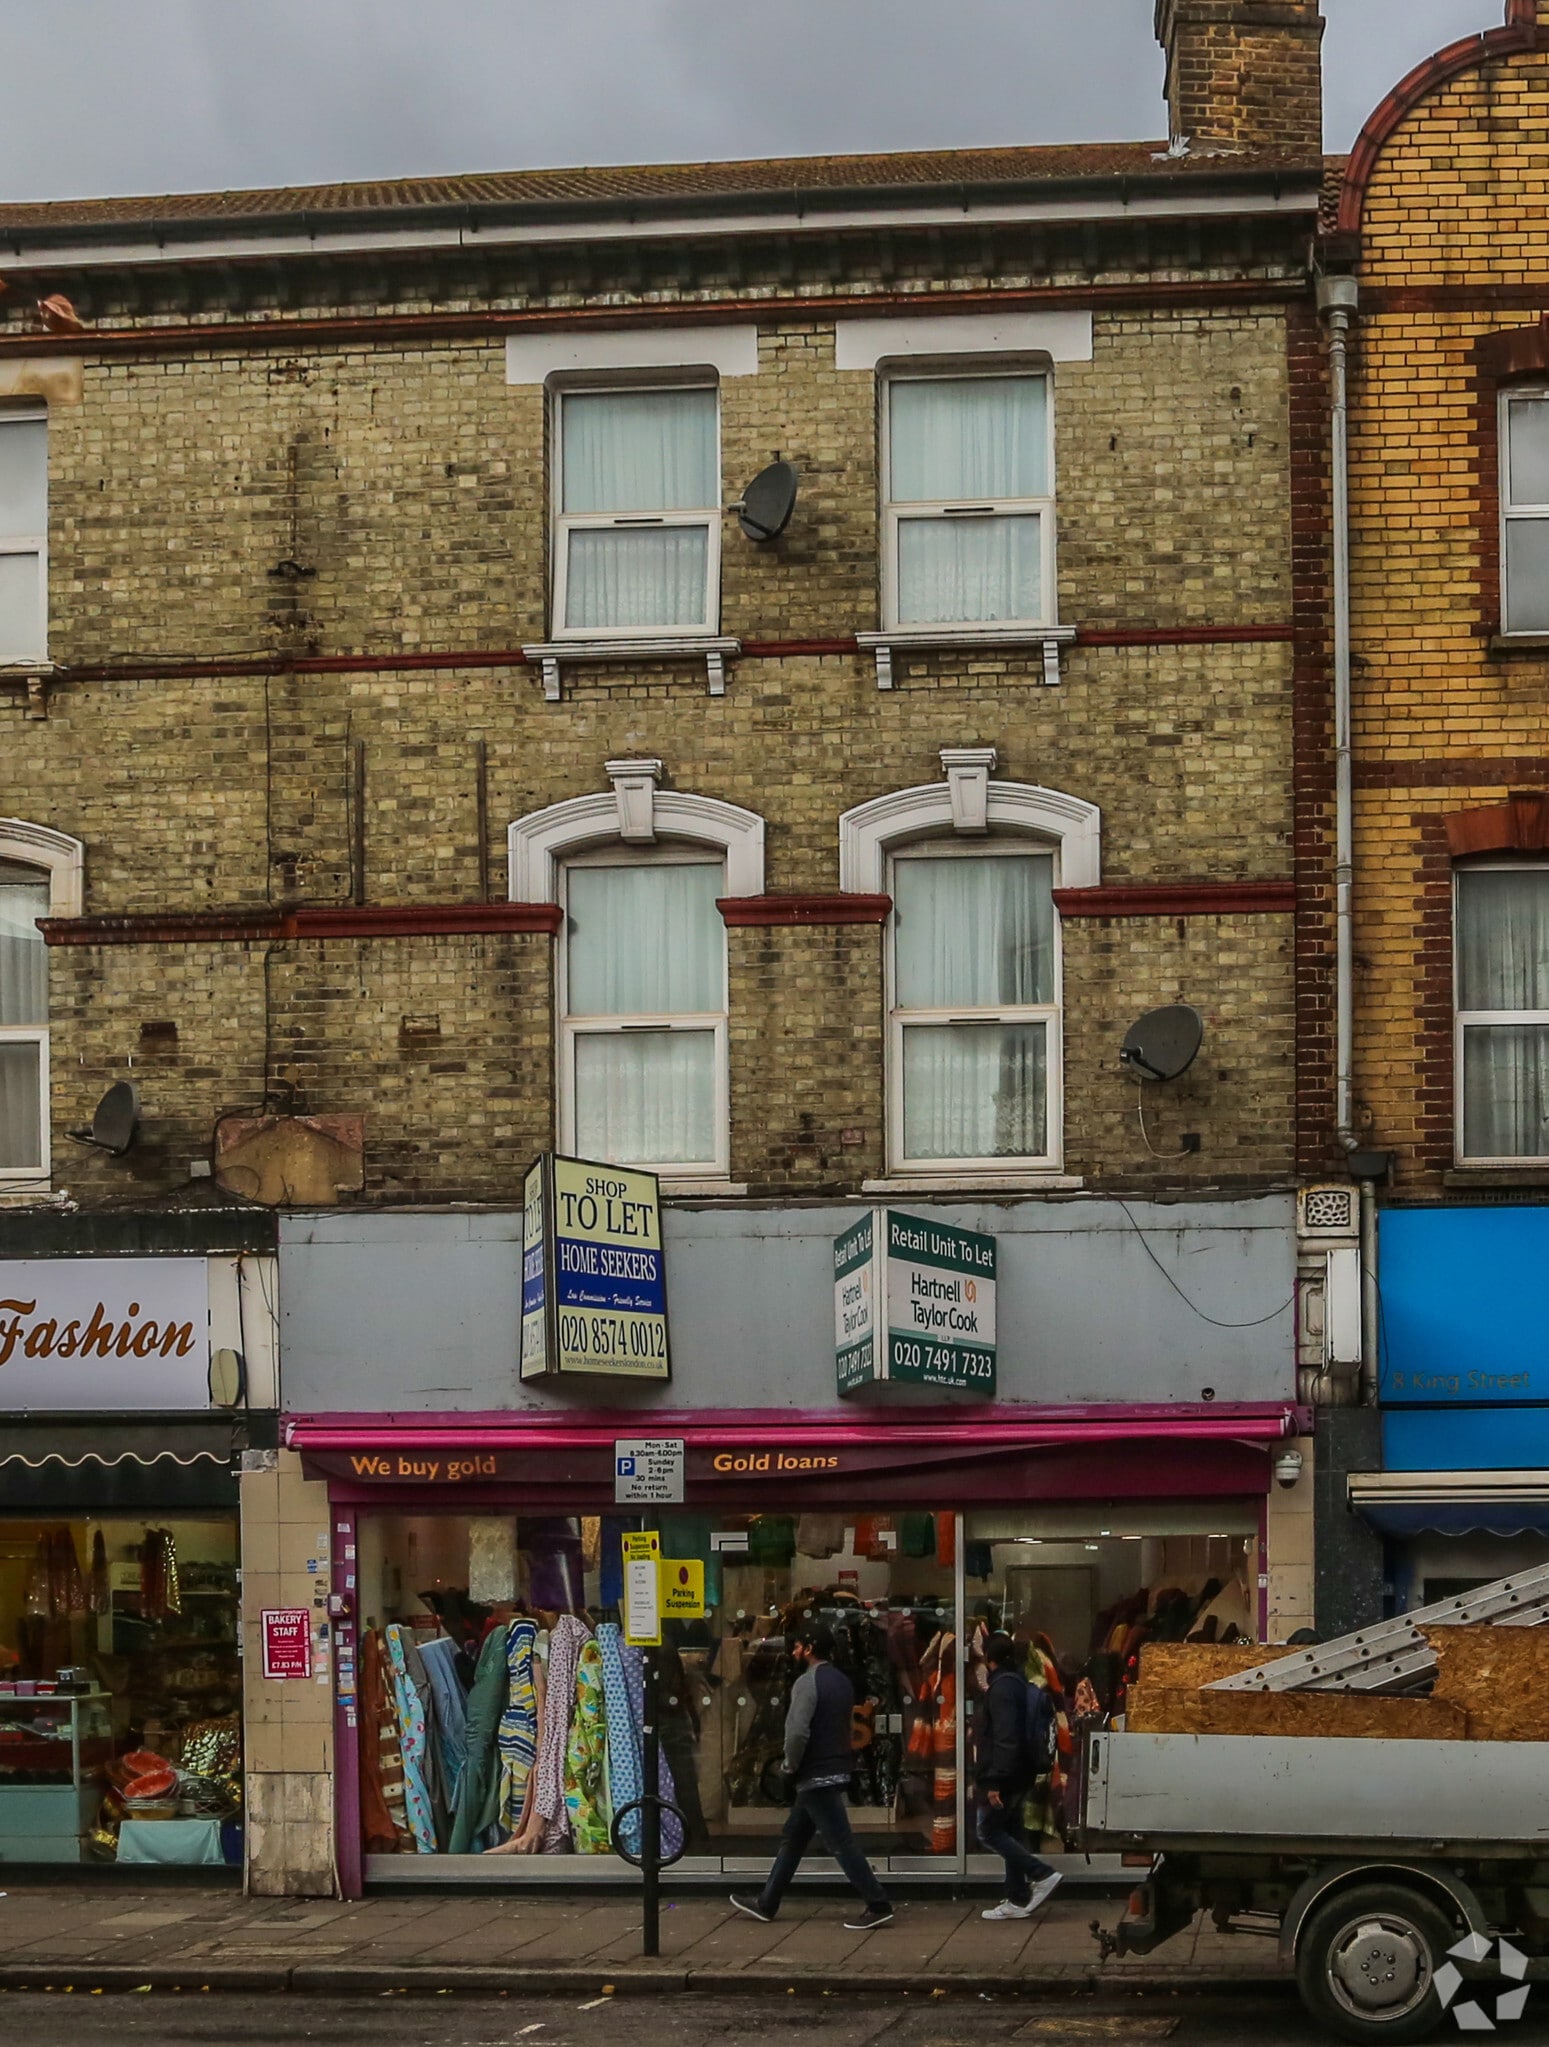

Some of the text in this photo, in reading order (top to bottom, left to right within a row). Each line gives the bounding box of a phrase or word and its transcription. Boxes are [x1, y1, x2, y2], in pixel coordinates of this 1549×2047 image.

[586, 1177, 627, 1199] SHOP
[560, 1191, 653, 1237] TO LET
[892, 1223, 993, 1267] Retail Unit To Let
[561, 1243, 599, 1275] HOME
[601, 1248, 657, 1281] SEEKERS
[912, 1272, 960, 1303] Hartnell
[911, 1300, 978, 1333] Taylor Cook
[0, 1299, 196, 1366] Fashion
[562, 1315, 588, 1353] 020
[592, 1317, 627, 1355] 8574
[630, 1321, 665, 1358] 0012
[894, 1342, 992, 1378] 020 7491 7323
[1392, 1370, 1530, 1395] 8 King Street
[351, 1452, 496, 1480] We buy gold
[621, 1460, 632, 1475] P
[713, 1453, 838, 1472] Gold loans
[665, 1599, 700, 1609] Suspension
[672, 1587, 695, 1599] Parking
[268, 1614, 302, 1625] BAKERY
[273, 1627, 299, 1637] STAFF
